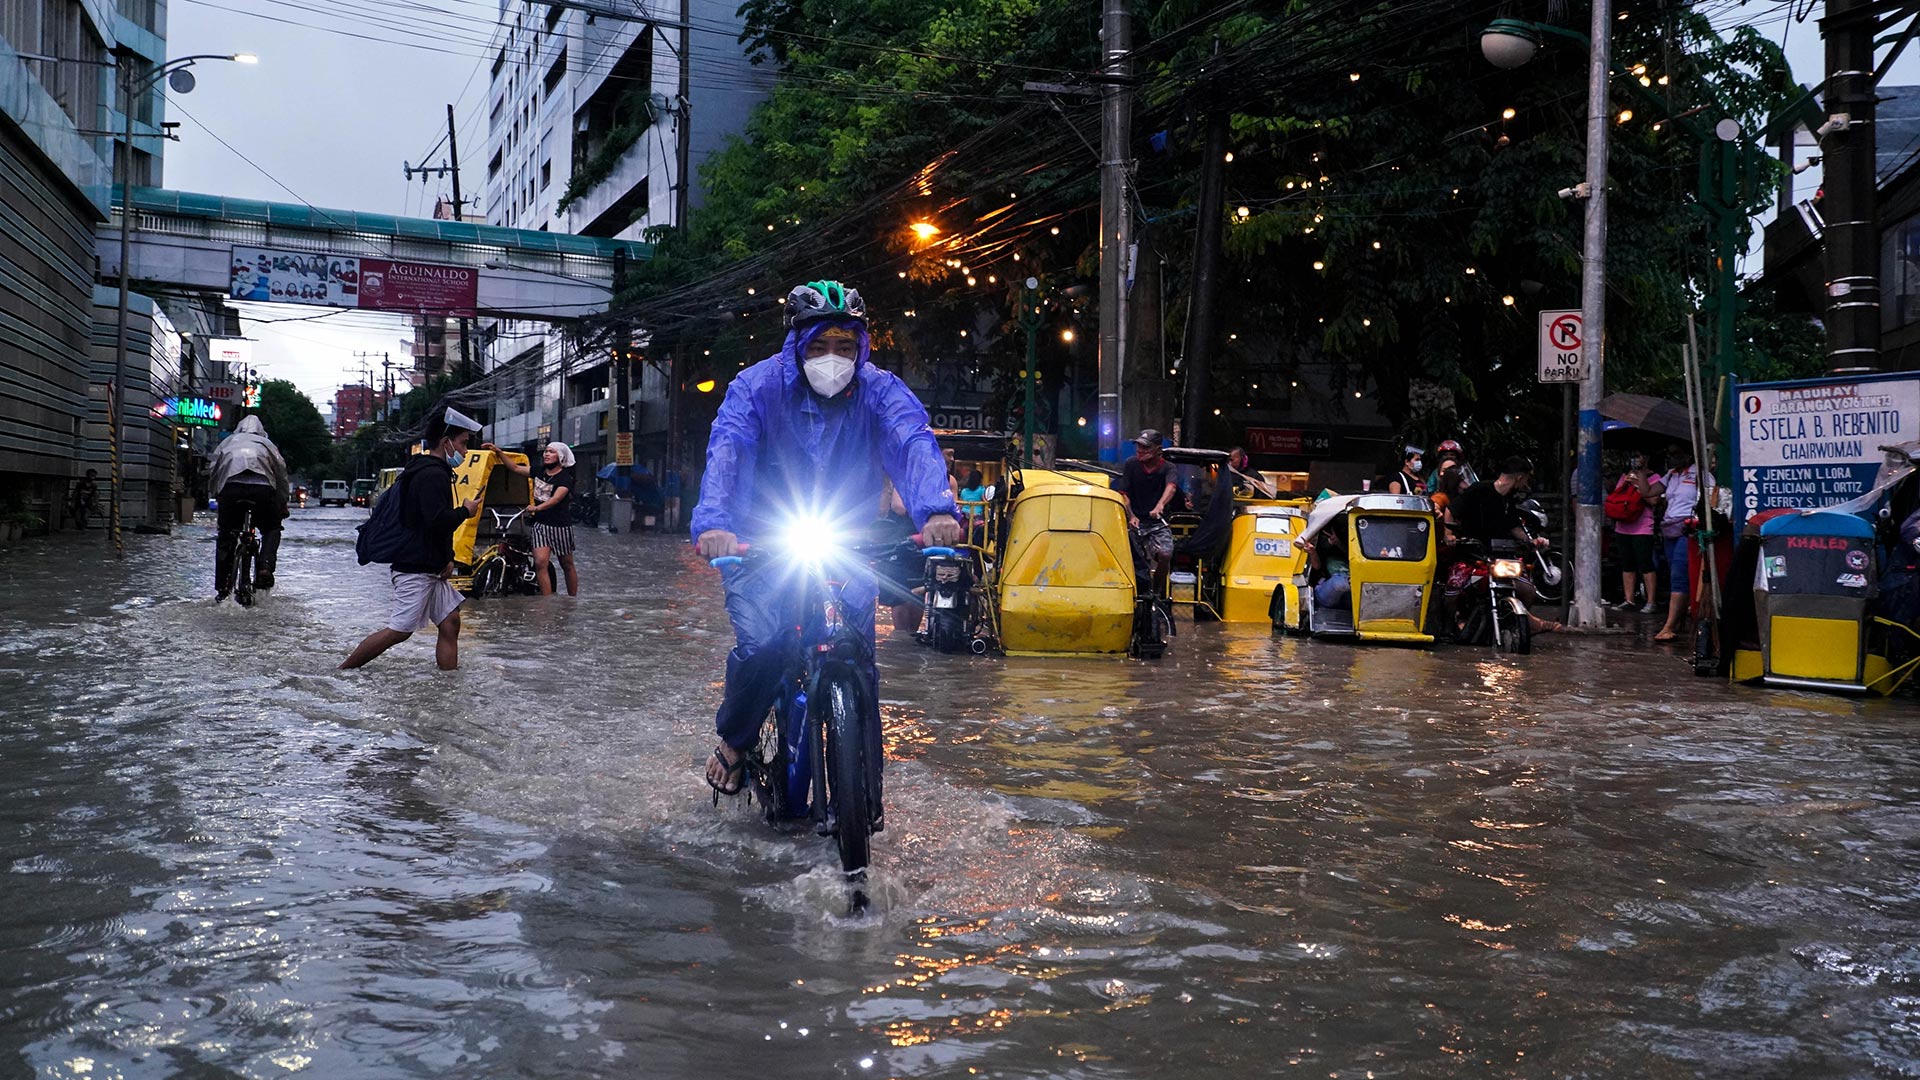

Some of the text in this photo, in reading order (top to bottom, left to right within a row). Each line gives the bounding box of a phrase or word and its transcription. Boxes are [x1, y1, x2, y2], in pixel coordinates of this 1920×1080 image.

[388, 263, 469, 281] AGUINALDO
[388, 274, 441, 284] INTERNATIONAL
[442, 279, 469, 287] SCHOOL
[1557, 352, 1578, 365] NO
[1780, 386, 1857, 401] MABUHAY!
[1771, 397, 1842, 415] BARANGAY
[1750, 410, 1900, 441] ESTELA B. REBENITO
[1782, 440, 1862, 460] CHAIRWOMAN
[1763, 468, 1812, 481] JENELYN
[1762, 481, 1862, 494] FELICIANO L. ORTIZ
[1763, 496, 1803, 508] JEFREY
[1256, 542, 1277, 552] 001
[1787, 537, 1848, 550] KHALED
